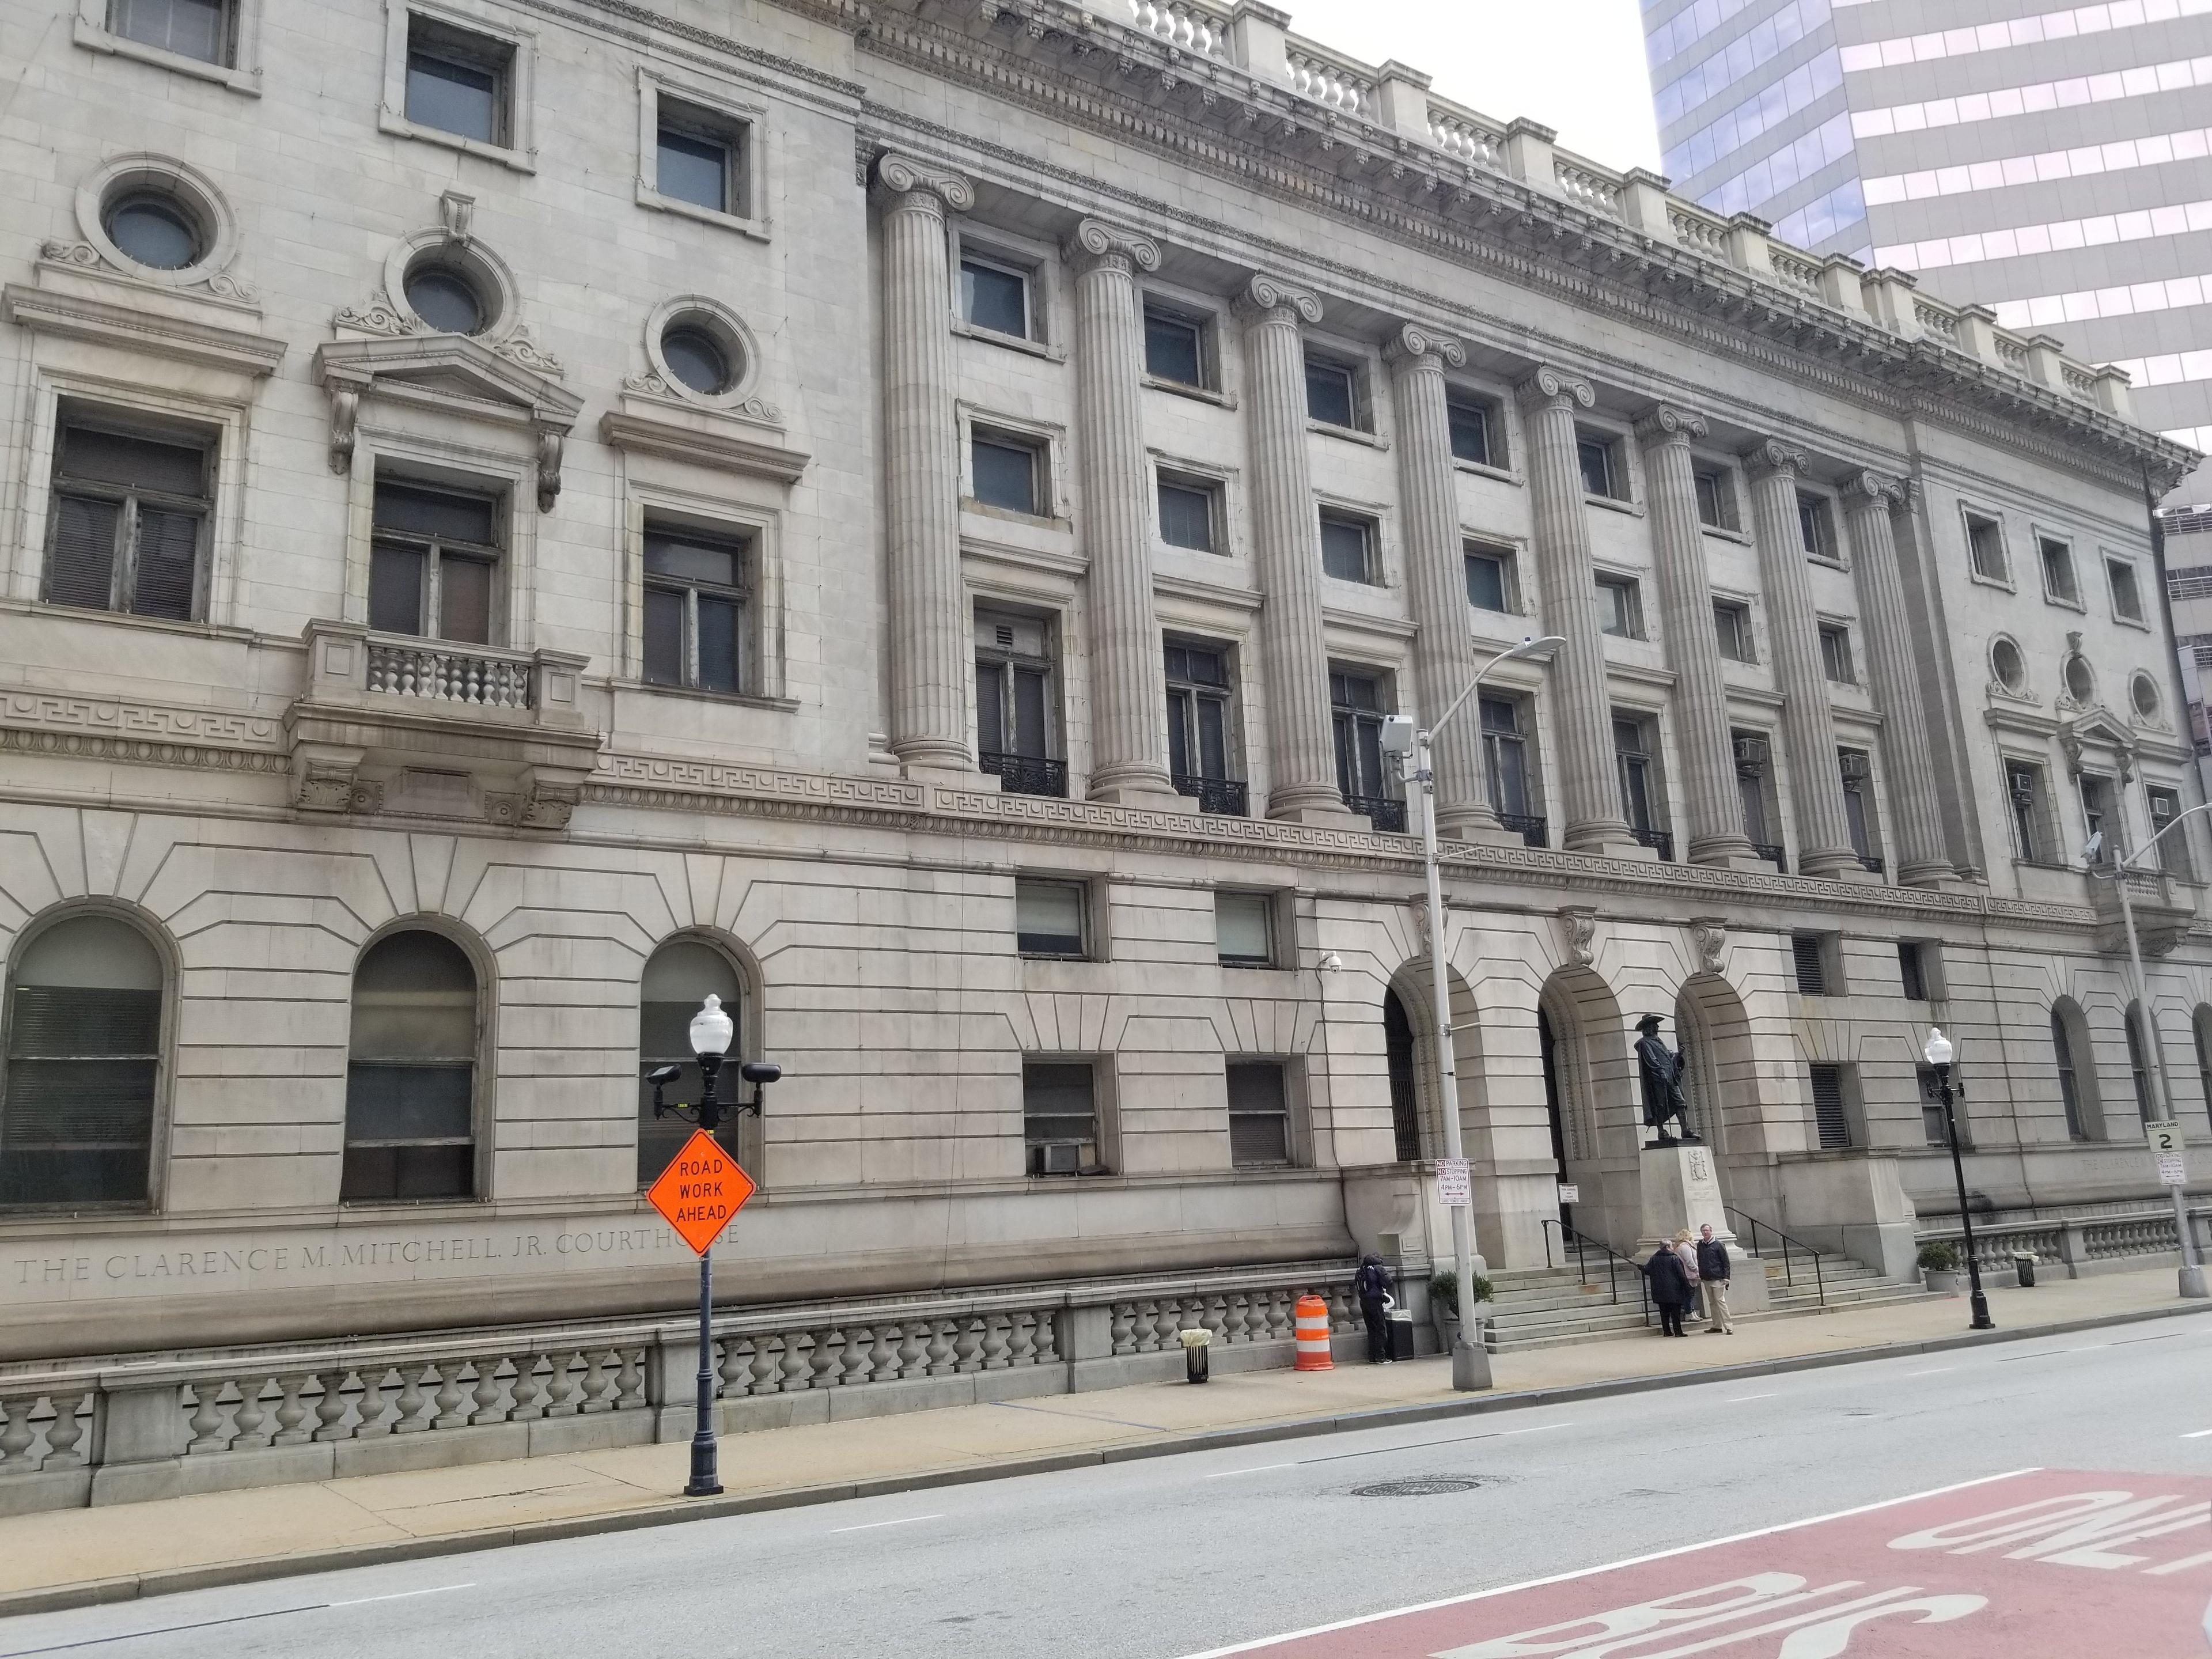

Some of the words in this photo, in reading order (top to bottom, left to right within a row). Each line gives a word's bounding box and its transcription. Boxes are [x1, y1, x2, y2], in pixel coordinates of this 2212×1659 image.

[2158, 1134, 2172, 1149] 2
[680, 1159, 723, 1176] ROAD
[680, 1181, 724, 1199] WORK
[676, 1205, 727, 1222] AHEAD
[14, 1257, 89, 1284] THE
[105, 1248, 289, 1279] CLARENCE
[301, 1246, 331, 1268] M.
[512, 1234, 547, 1257] JR.
[1887, 1490, 2212, 1575] ONL
